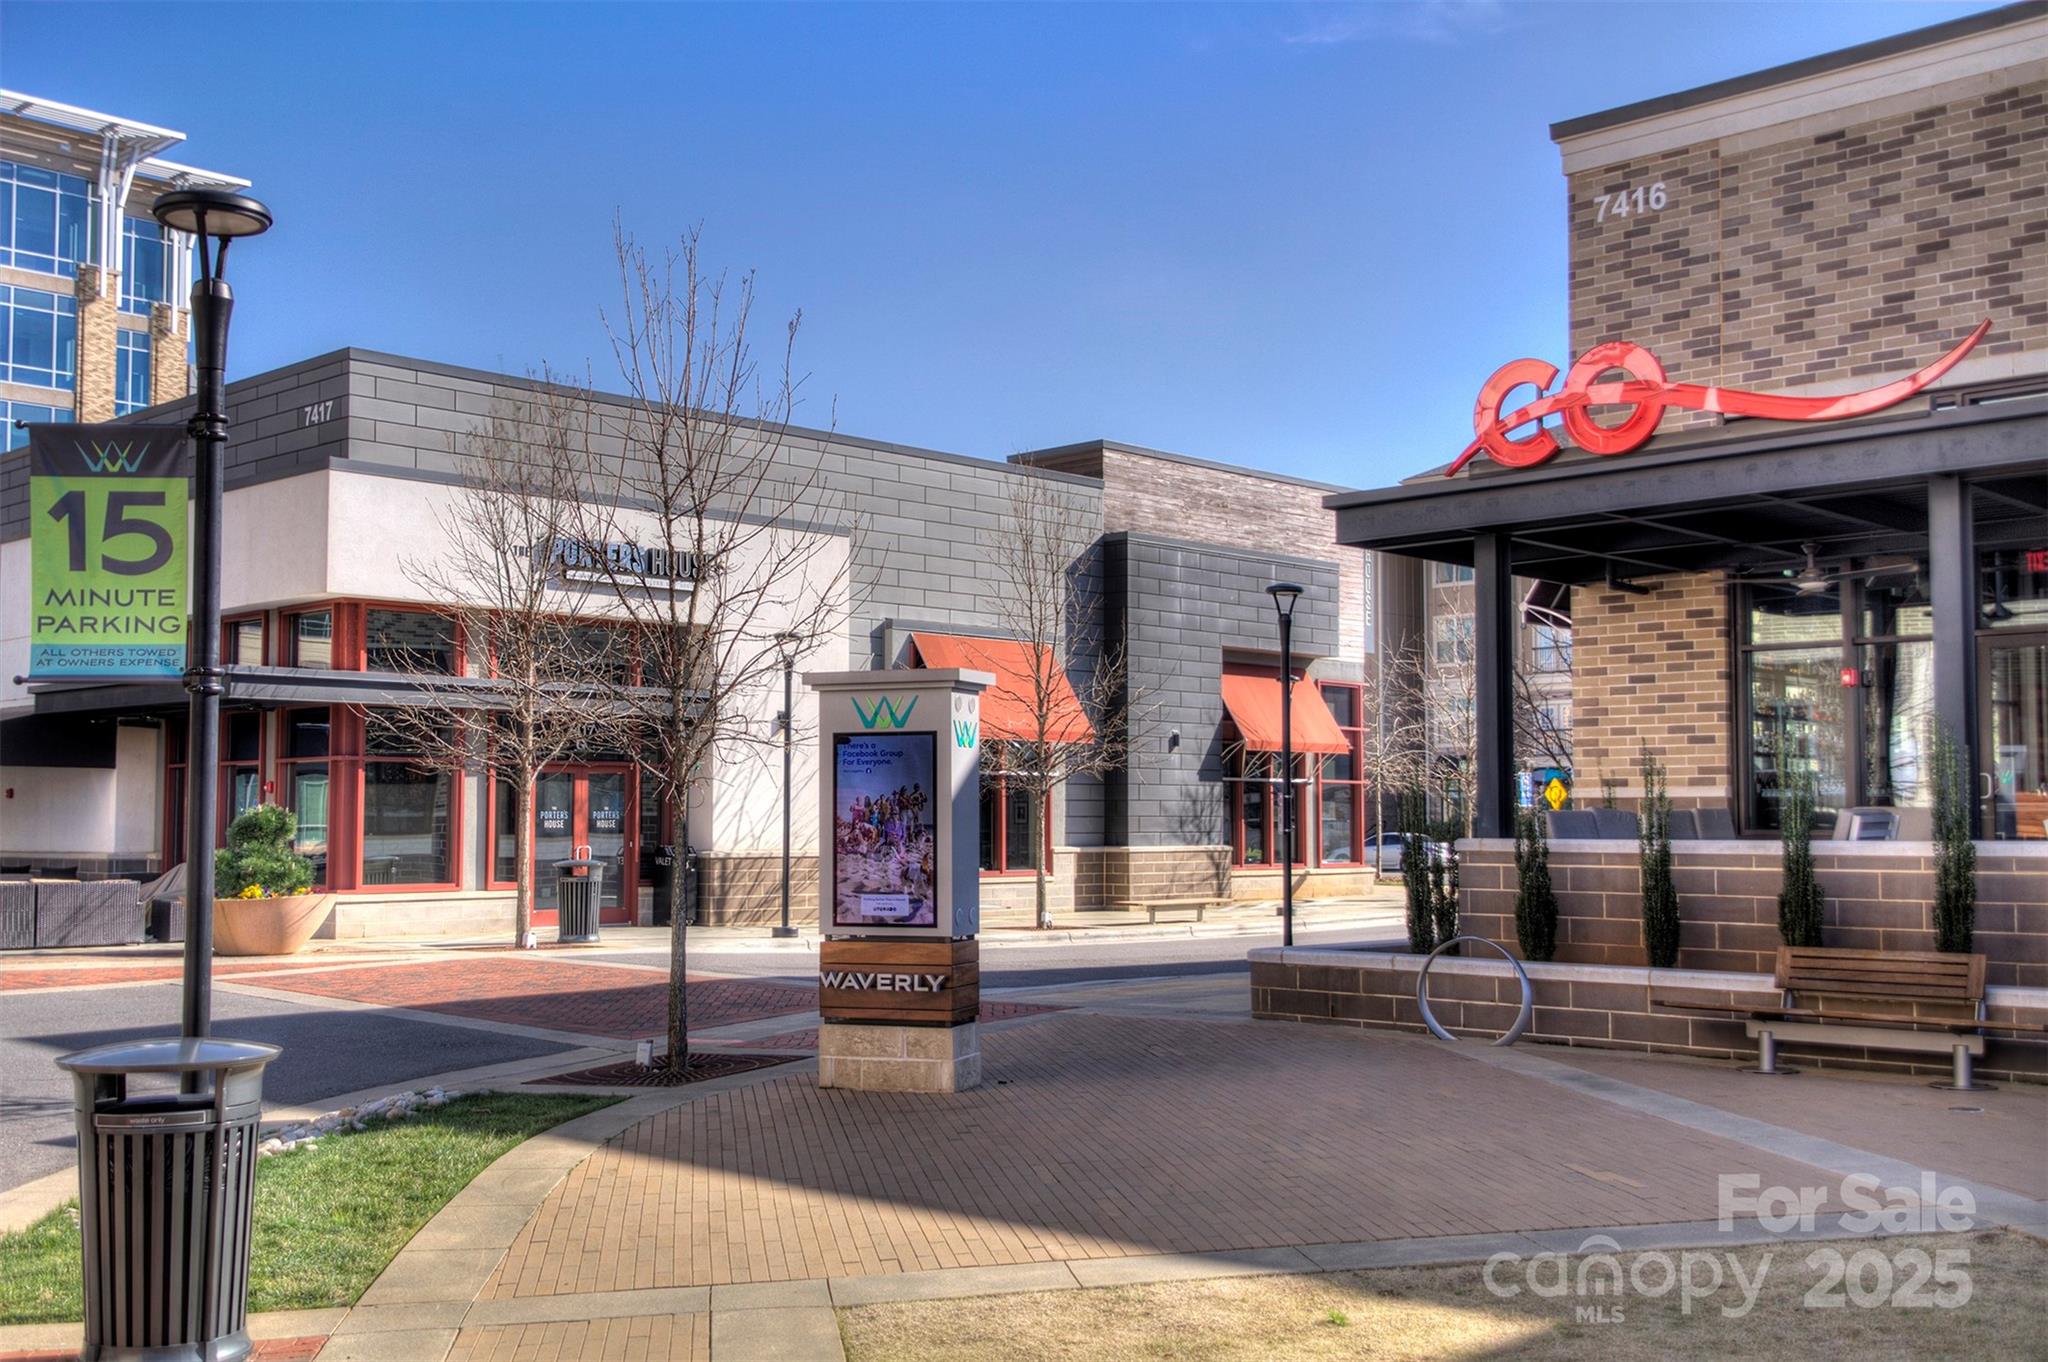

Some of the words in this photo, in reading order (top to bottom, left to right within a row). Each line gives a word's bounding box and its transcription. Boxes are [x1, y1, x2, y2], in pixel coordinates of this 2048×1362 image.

[1593, 181, 1667, 223] 7416
[304, 400, 333, 427] 7417
[47, 490, 174, 576] 15
[513, 545, 529, 557] THE
[45, 588, 176, 607] MINUTE
[37, 615, 181, 634] PARKING
[40, 648, 66, 656] ALL
[70, 648, 124, 656] OTHERS
[128, 648, 176, 656] TOWED
[36, 658, 54, 667] AT
[57, 658, 115, 667] OWNERS
[119, 658, 180, 667] EXPENSE
[880, 750, 904, 758] Group
[544, 819, 565, 829] HOUSE
[596, 819, 616, 829] HOUSE
[655, 857, 672, 866] VALET
[819, 971, 945, 992] WAVERLY
